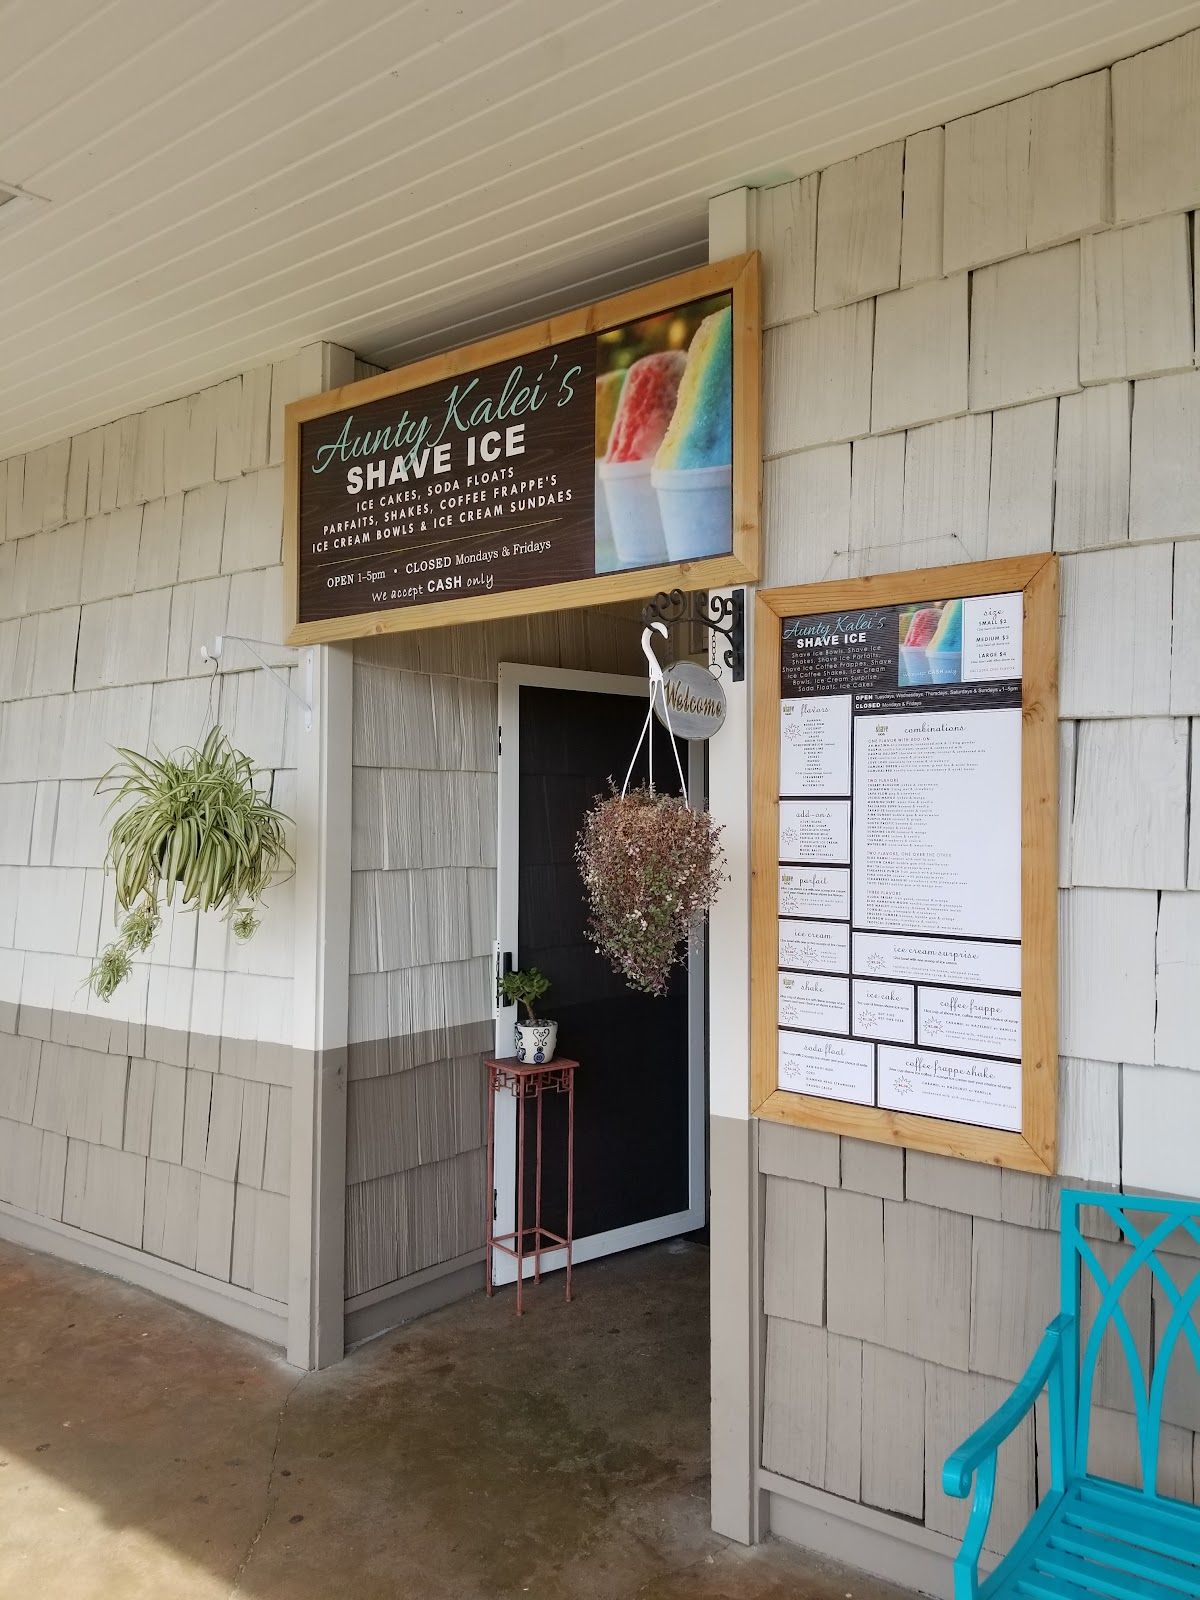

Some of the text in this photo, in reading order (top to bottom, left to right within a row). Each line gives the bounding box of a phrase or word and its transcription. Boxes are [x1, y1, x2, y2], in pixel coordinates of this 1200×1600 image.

[312, 354, 582, 474] Aunty Kalei's
[346, 424, 526, 495] SHAVE ICE
[356, 466, 514, 513] ICE CAKES, SODA FLOATS
[323, 474, 558, 536] PARFAITS, SHAKES, COFFEE FRAPPE'S
[311, 489, 573, 554] ICE CREAM BOWLS & ICE CREAM SUNDAES
[327, 573, 354, 588] OPEN
[405, 556, 452, 575] CLOSED
[455, 550, 499, 566] Mondays
[501, 546, 511, 557] &
[513, 540, 552, 556] Fridays
[371, 572, 494, 602] We accept CASH only
[782, 612, 887, 641] Aunty Kalei's
[796, 632, 867, 649] SHAVE ICE
[664, 679, 723, 718] Welcome
[801, 703, 830, 717] flavors
[904, 722, 965, 734] combinations
[799, 874, 828, 888] parfait
[807, 931, 831, 940] cream
[893, 945, 906, 953] ice
[908, 948, 935, 956] cream
[937, 950, 978, 962] surprise
[800, 981, 824, 993] shake
[880, 991, 901, 1002] cake
[939, 997, 968, 1012] coffee
[969, 999, 1002, 1017] frappe
[803, 1044, 823, 1053] soda
[905, 1057, 932, 1072] coffee
[933, 1060, 965, 1078] frappe
[966, 1065, 996, 1080] shake
